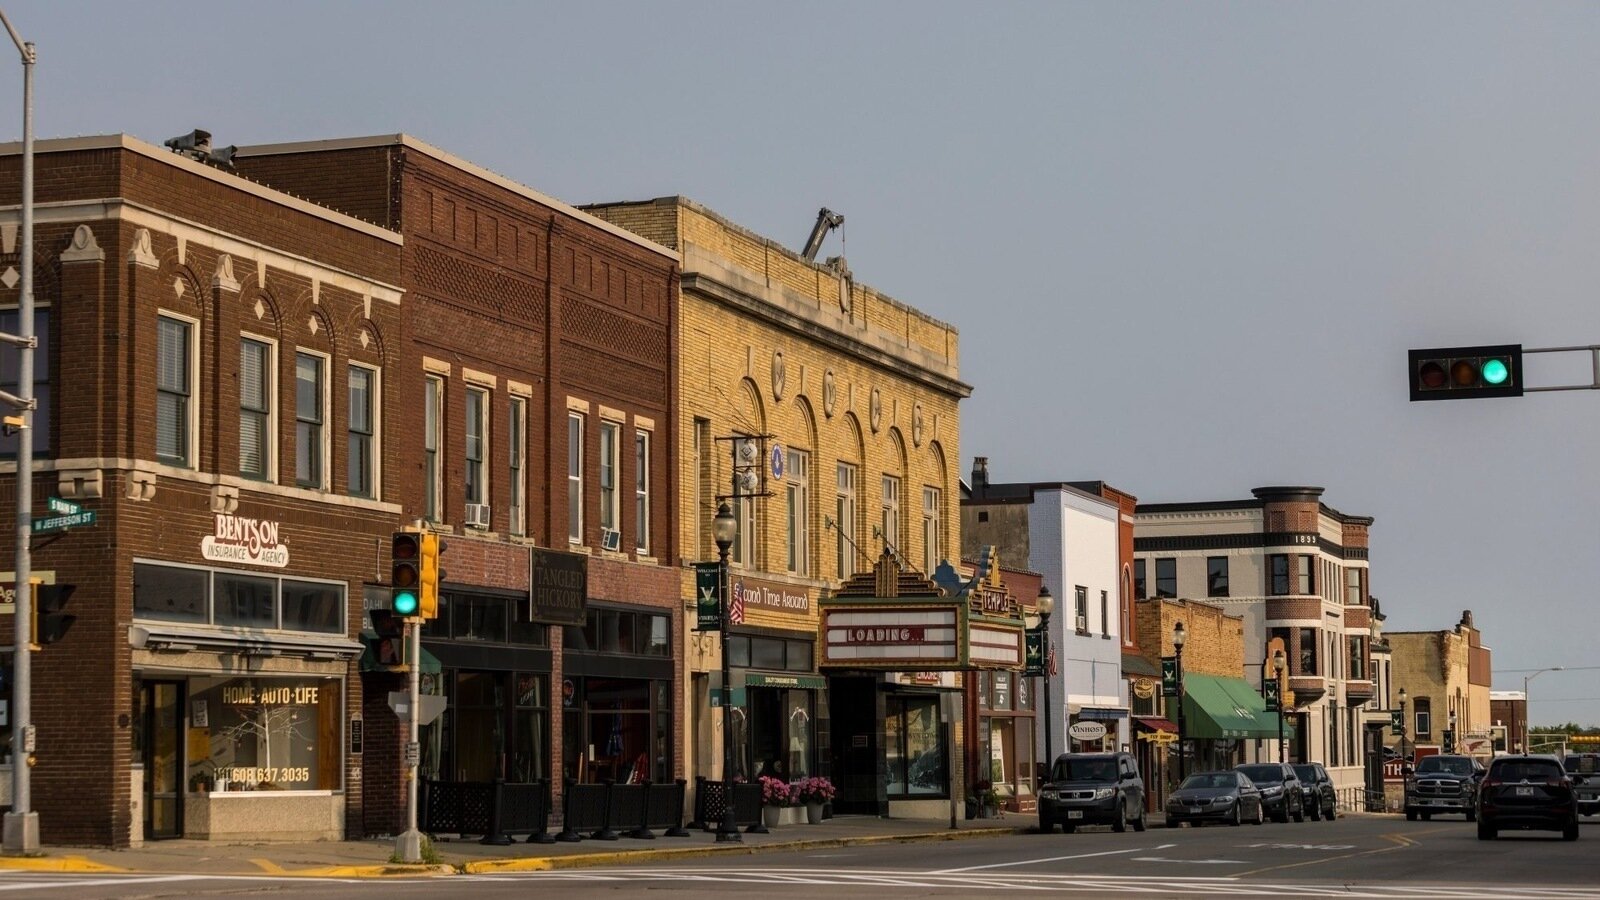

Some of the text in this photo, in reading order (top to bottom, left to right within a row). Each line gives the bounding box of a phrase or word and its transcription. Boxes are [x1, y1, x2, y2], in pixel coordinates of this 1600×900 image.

[43, 514, 81, 529] JEFFERSON
[82, 512, 92, 523] ST
[215, 514, 279, 554] BENTSON
[207, 545, 247, 560] INSURANCE
[261, 551, 286, 564] AGENCY
[536, 566, 584, 590] TANGLED
[537, 587, 584, 609] HICKORY
[983, 590, 1009, 612] TEMPLE
[223, 687, 319, 704] HOME AUTO LIFE
[232, 767, 310, 783] 608.637.3035
